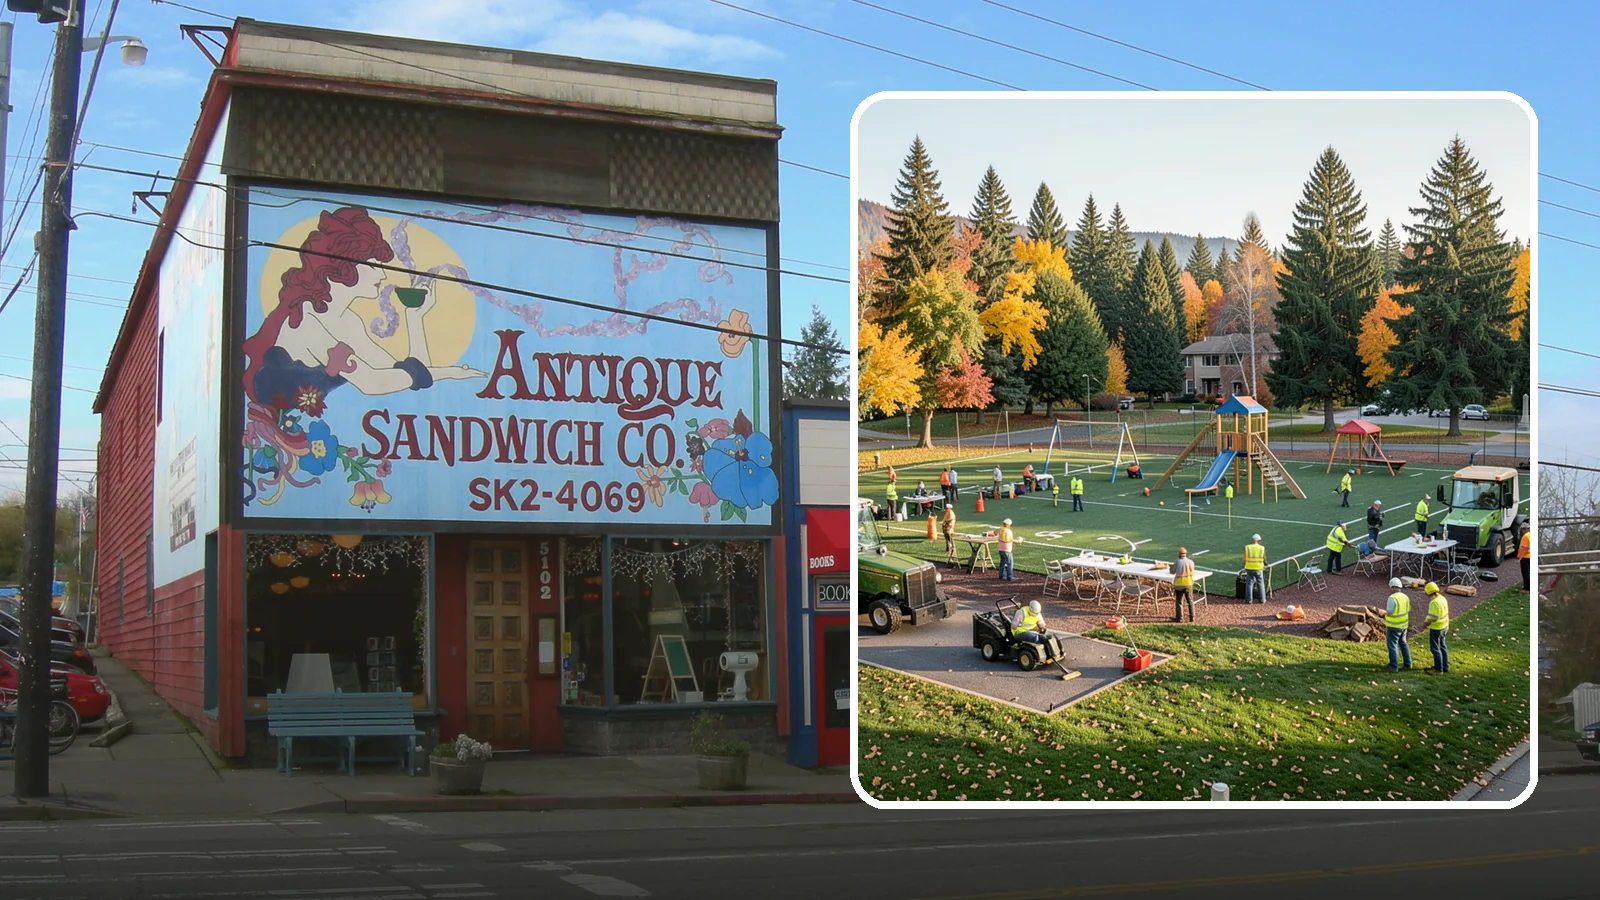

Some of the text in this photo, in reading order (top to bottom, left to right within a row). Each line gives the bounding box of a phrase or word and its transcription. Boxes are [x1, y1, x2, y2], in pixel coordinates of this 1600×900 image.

[476, 329, 724, 420] ANTIQUE
[361, 409, 684, 470] SANDWICH CO.
[469, 478, 645, 514] SK2-4069
[540, 542, 551, 599] 5102
[809, 555, 834, 568] BOOKS
